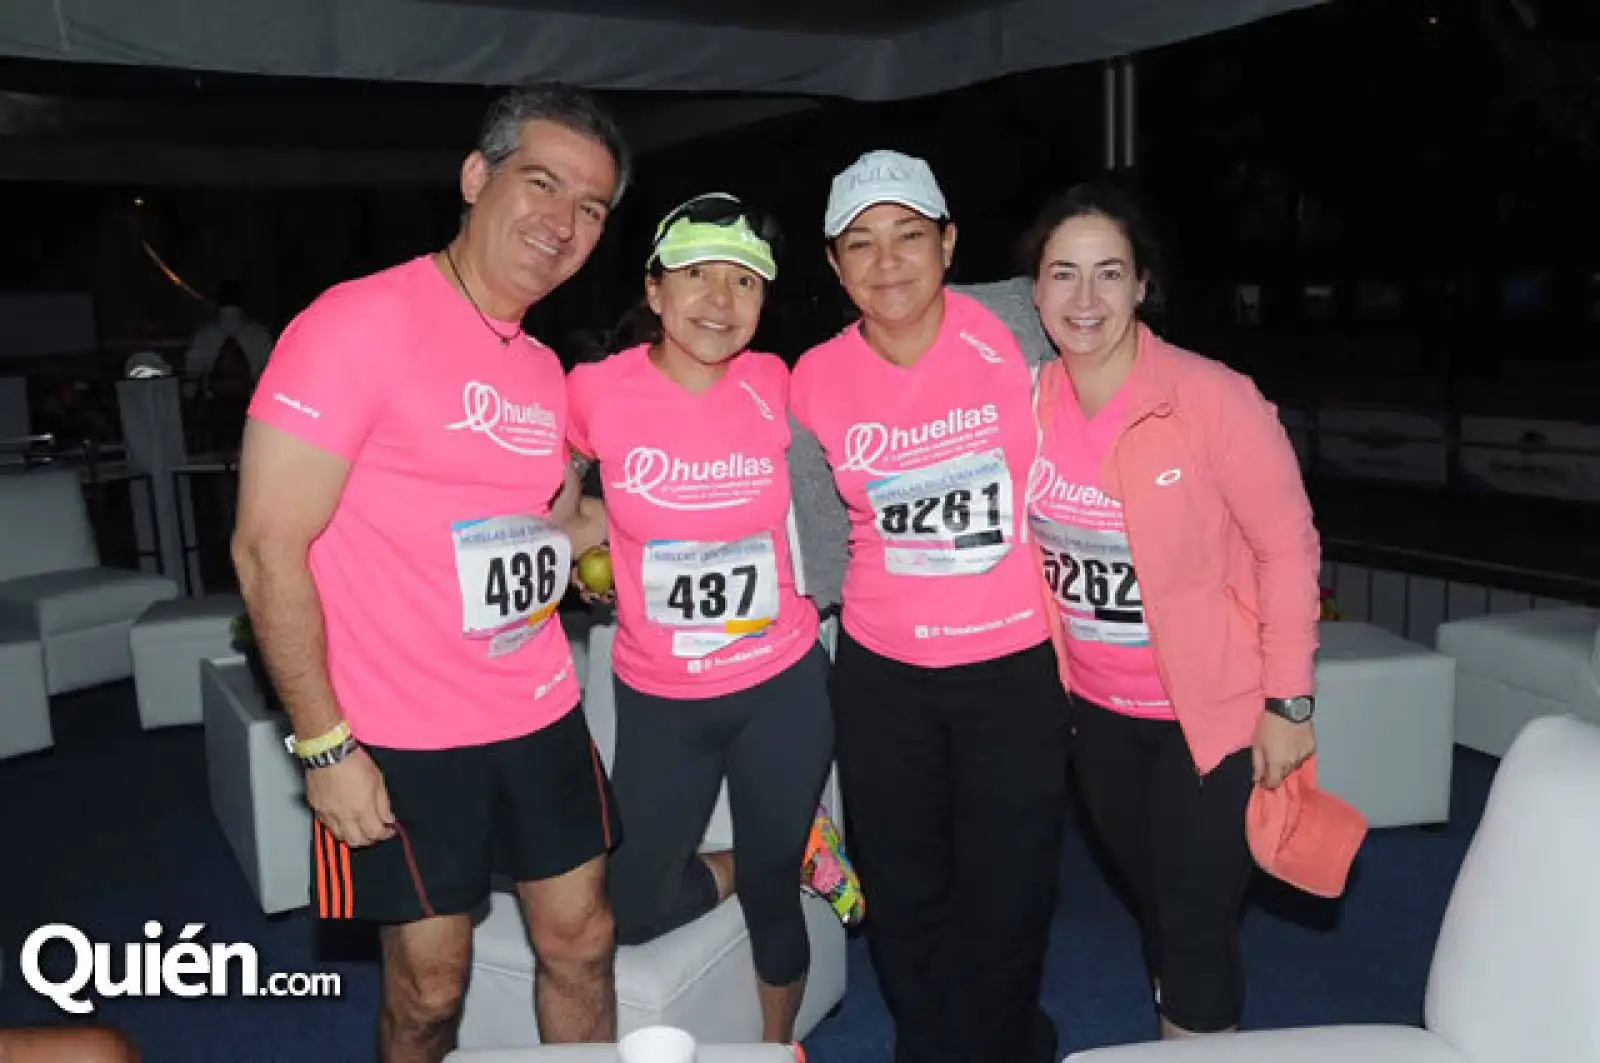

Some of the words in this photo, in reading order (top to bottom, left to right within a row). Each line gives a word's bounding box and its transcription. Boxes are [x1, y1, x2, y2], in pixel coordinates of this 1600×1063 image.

[891, 404, 998, 451] huellas
[671, 452, 773, 481] huellas
[485, 544, 557, 616] 436
[667, 564, 758, 620] 437
